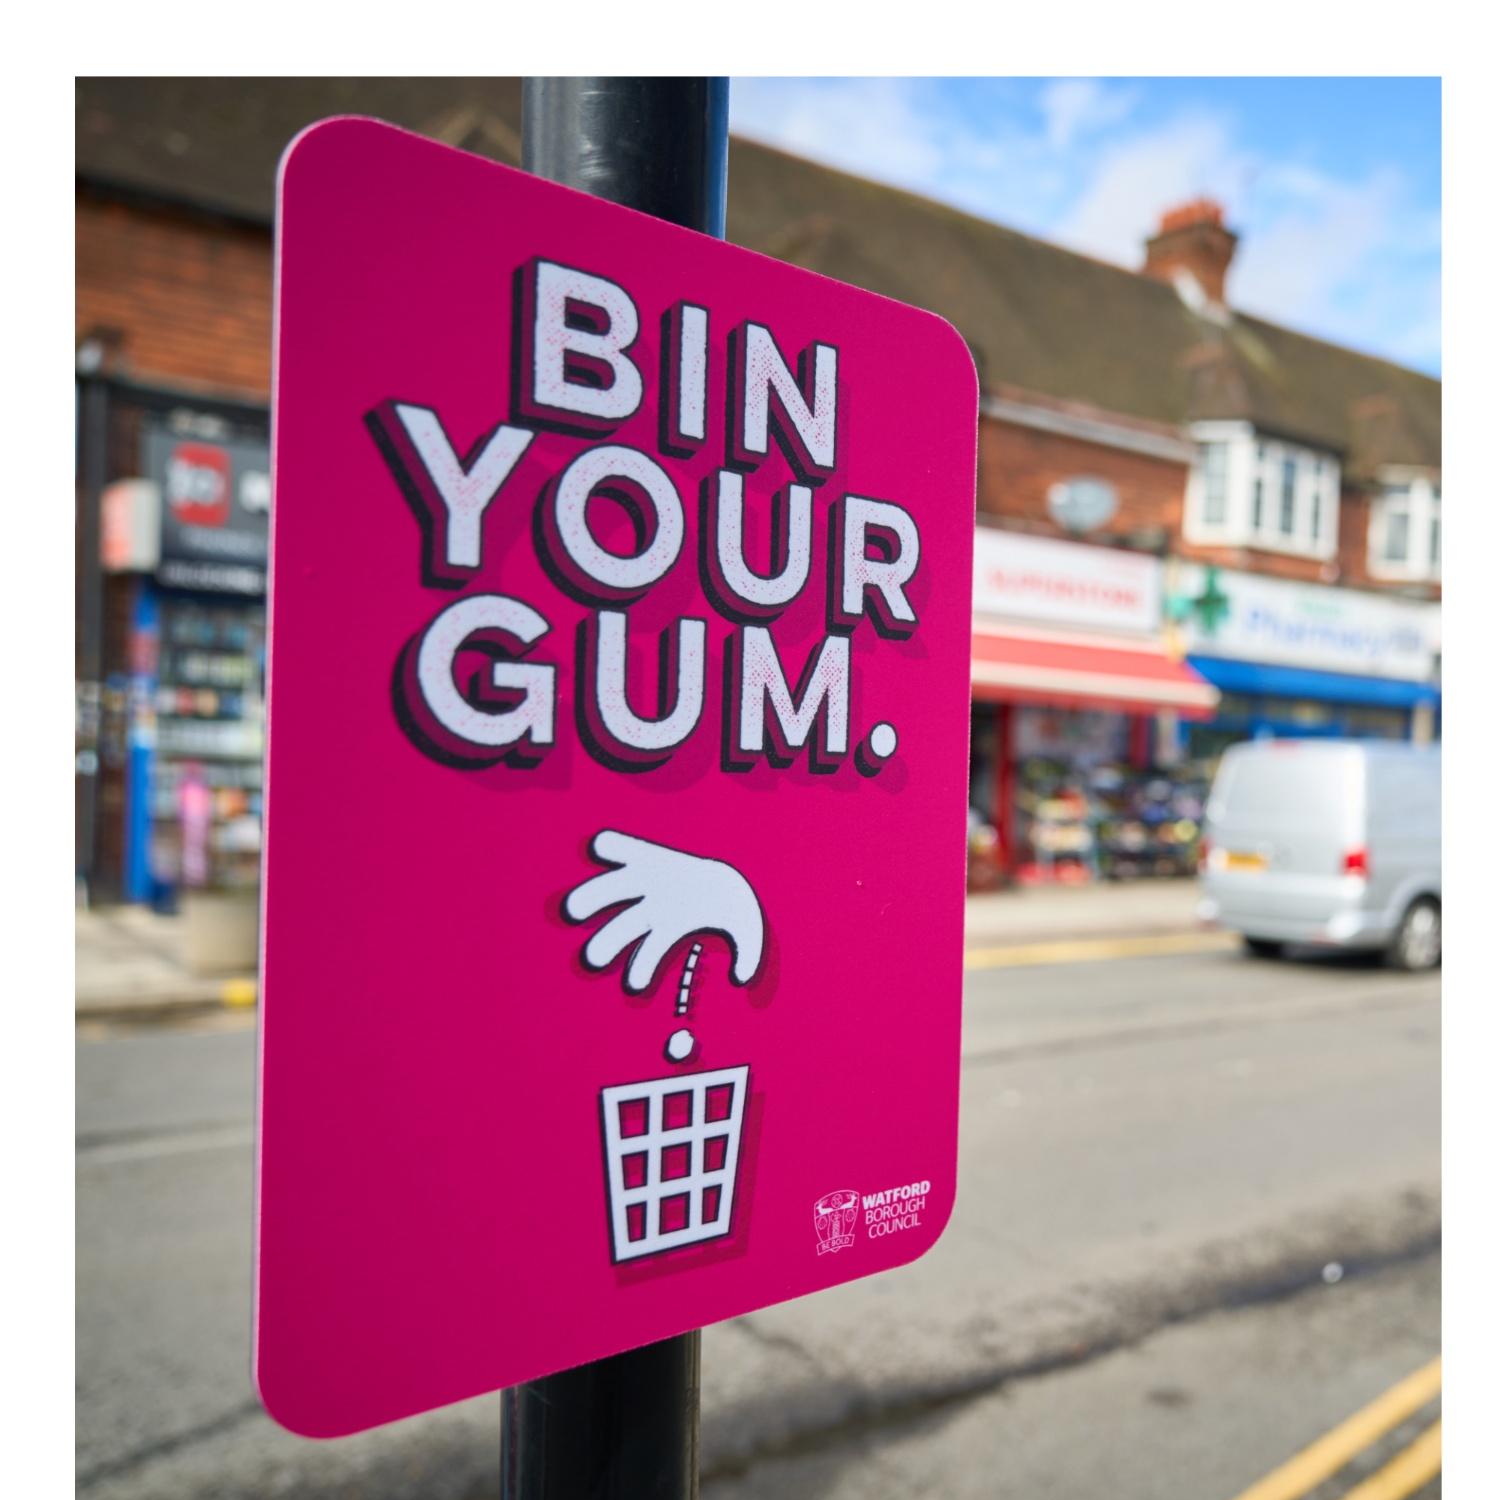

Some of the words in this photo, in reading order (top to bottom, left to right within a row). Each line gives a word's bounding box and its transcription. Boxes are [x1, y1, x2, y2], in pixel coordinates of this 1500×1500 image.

[509, 255, 840, 487] BIN
[363, 397, 920, 640] YOUR
[391, 593, 897, 777] GUM.
[862, 1180, 931, 1210] WATFORD
[865, 1197, 926, 1225] BOROUGH
[868, 1213, 922, 1239] COUNCIL
[821, 1240, 831, 1251] BE
[831, 1236, 850, 1248] BOLD
